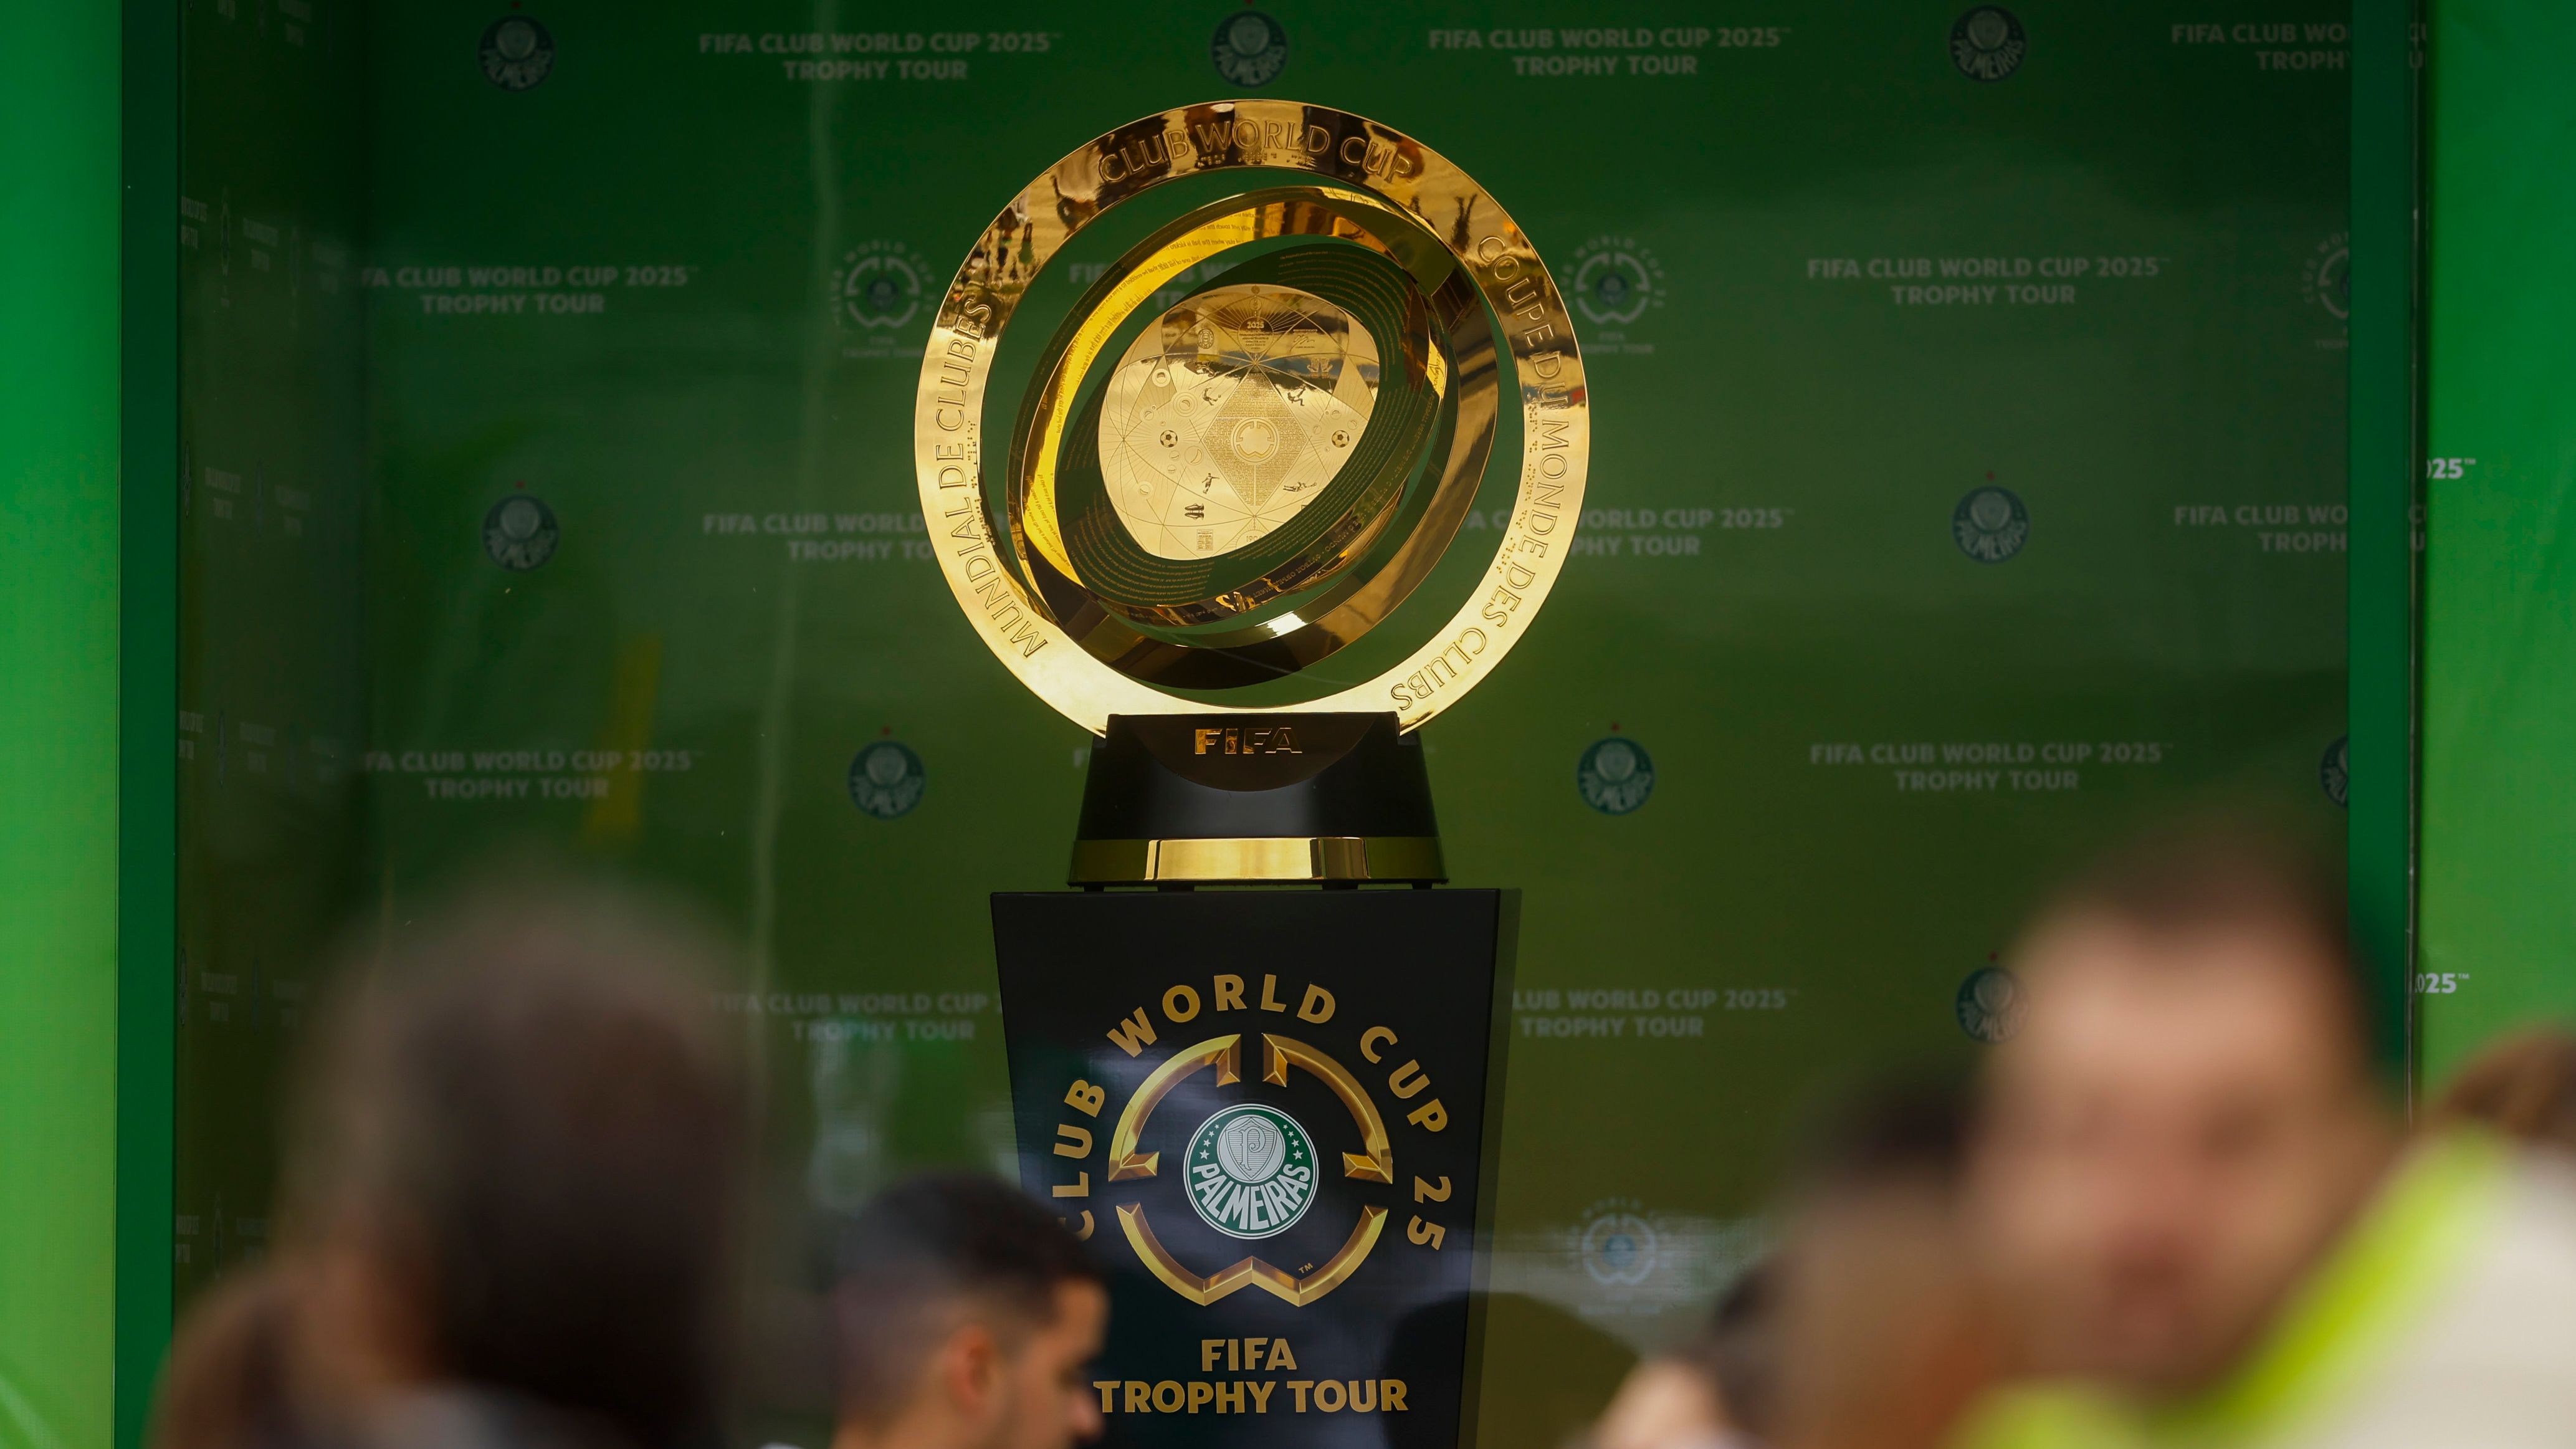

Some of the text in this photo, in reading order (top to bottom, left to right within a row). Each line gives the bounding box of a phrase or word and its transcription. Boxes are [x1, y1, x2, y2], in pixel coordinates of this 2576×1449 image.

[700, 33, 753, 54] FIFA
[759, 33, 825, 54] CLUB
[831, 33, 924, 54] WORLD
[929, 32, 982, 52] CUP
[1429, 29, 1484, 49] FIFA
[1488, 29, 1555, 50] CLUB
[1560, 28, 1654, 49] WORLD
[1659, 27, 1711, 48] CUP
[2171, 24, 2226, 44] FIFA
[2231, 23, 2297, 44] CLUB
[783, 59, 968, 81] TROPHY TOUR
[1512, 55, 1697, 76] TROPHY TOUR
[2255, 50, 2350, 70] TROPH
[1098, 119, 1418, 183] CLUB WORLD CUP
[361, 267, 390, 288] FA
[396, 267, 462, 288] CLUB
[468, 266, 561, 288] WORLD
[566, 265, 619, 287] CUP
[1807, 259, 1861, 278] FIFA
[1867, 258, 1932, 279] CLUB
[1939, 258, 2031, 279] WORLD
[2038, 257, 2090, 277] CUP
[1477, 236, 1553, 345] COUPE
[1891, 284, 2075, 305] TROPHY TOUR
[420, 293, 604, 314] TROPHY TOUR
[1533, 350, 1569, 408] DU
[935, 297, 1048, 658] MUNDIAL DE CLUBES
[1520, 421, 1569, 559] MONDE
[704, 512, 925, 535] FIFA CLUB WORLD
[1661, 509, 1715, 529] CUP
[2175, 505, 2228, 525] FIFA
[2235, 505, 2299, 525] CLUB
[787, 540, 932, 562] TROPHY TO
[1571, 535, 1700, 557] PHY TOUR
[2258, 533, 2348, 552] TROPH
[1481, 562, 1535, 628] DES
[1390, 628, 1487, 711] CLUBS
[1195, 726, 1303, 756] FIFA
[365, 751, 394, 772] FA
[400, 751, 465, 772] CLUB
[472, 750, 565, 772] WORLD
[571, 750, 622, 771] CUP
[1811, 744, 1864, 764] FIFA
[1871, 743, 1935, 764] CLUB
[1942, 743, 2035, 764] WORLD
[2041, 742, 2092, 763] CUP
[426, 776, 608, 799] TROPHY TOUR
[1894, 769, 2079, 791] TROPHY TOUR
[2415, 972, 2470, 993] 025™
[768, 993, 832, 1015] CLUB
[838, 993, 931, 1015] WORLD
[937, 993, 989, 1013] CUP
[1512, 990, 1561, 1011] LUB
[1567, 989, 1661, 1010] WORLD
[1666, 989, 1717, 1010] CUP
[905, 1020, 975, 1041] TOUR
[1520, 1016, 1704, 1037] TROPHY TOUR
[1107, 973, 1337, 1058] WORLD
[1360, 1025, 1449, 1132] CUP
[1407, 1175, 1452, 1251] 25
[1192, 1163, 1311, 1231] PALMEIRAS
[1201, 1337, 1297, 1372] FIFA
[1094, 1379, 1409, 1414] TROPHY TOUR
